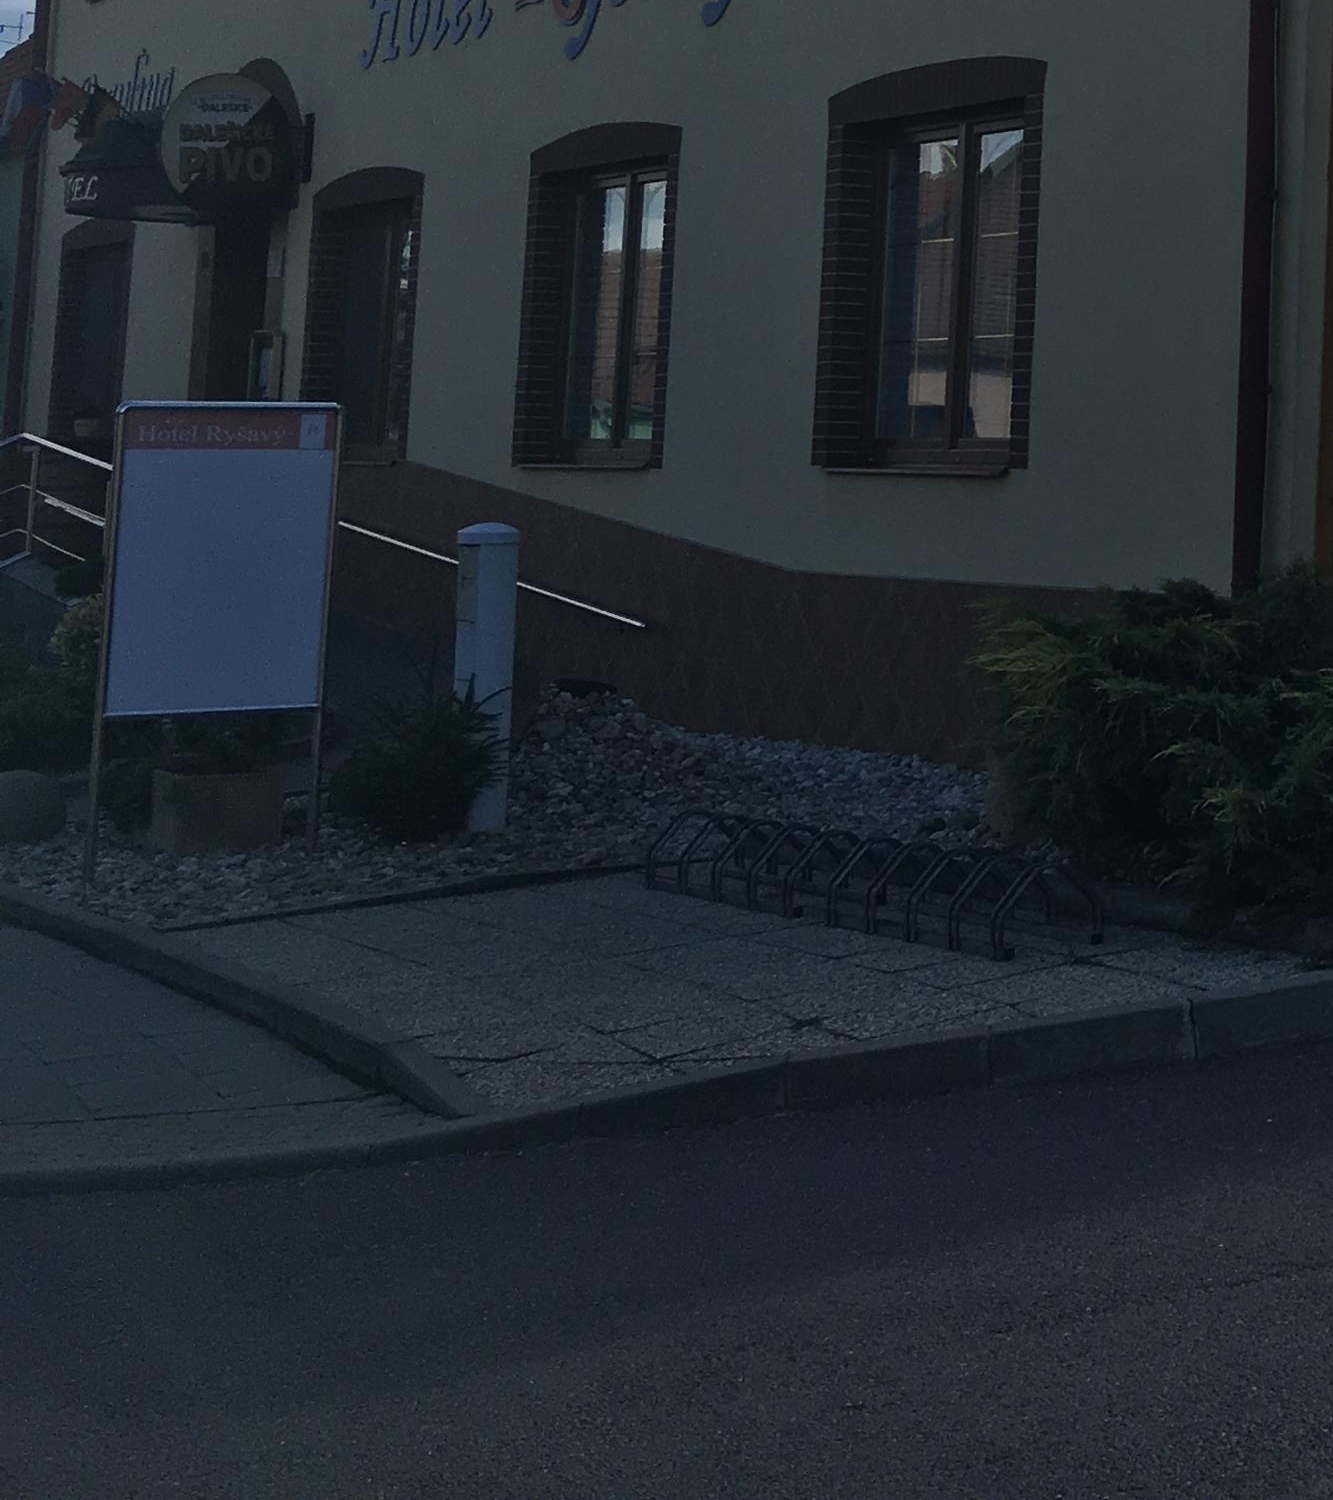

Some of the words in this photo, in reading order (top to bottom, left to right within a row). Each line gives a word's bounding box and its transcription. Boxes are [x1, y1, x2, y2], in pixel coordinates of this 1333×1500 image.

[178, 145, 273, 184] PIVO
[137, 424, 198, 443] Hotel
[206, 421, 286, 447] Ryšavý
